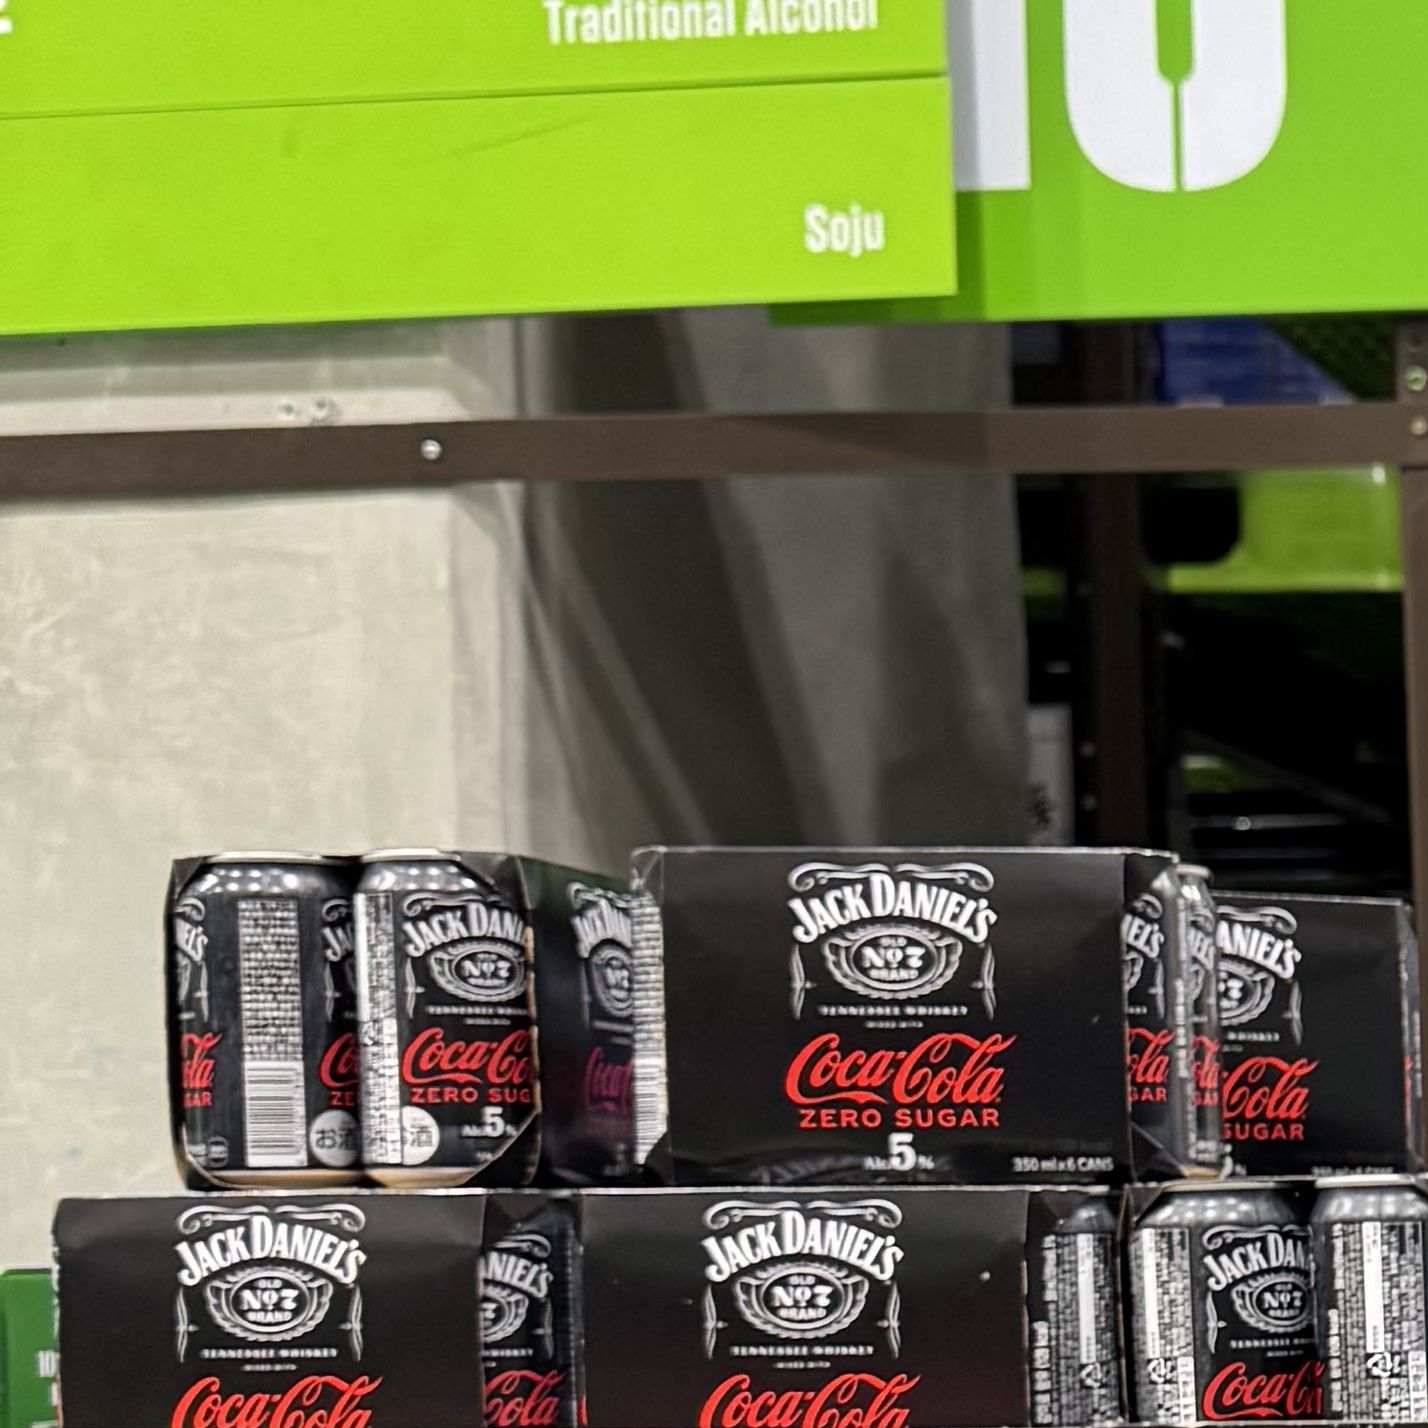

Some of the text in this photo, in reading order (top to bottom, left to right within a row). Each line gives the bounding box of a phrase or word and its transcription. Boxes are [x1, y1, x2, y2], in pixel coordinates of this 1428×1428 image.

[803, 203, 885, 256] Soju
[789, 872, 998, 946] JACK DANIEL'S
[784, 1032, 1018, 1106] Coca-Cola
[799, 1108, 1001, 1129] ZERO SUGAR
[174, 1214, 367, 1287] JACK DANIEL'S
[701, 1210, 904, 1283] JACK DANIEL'S
